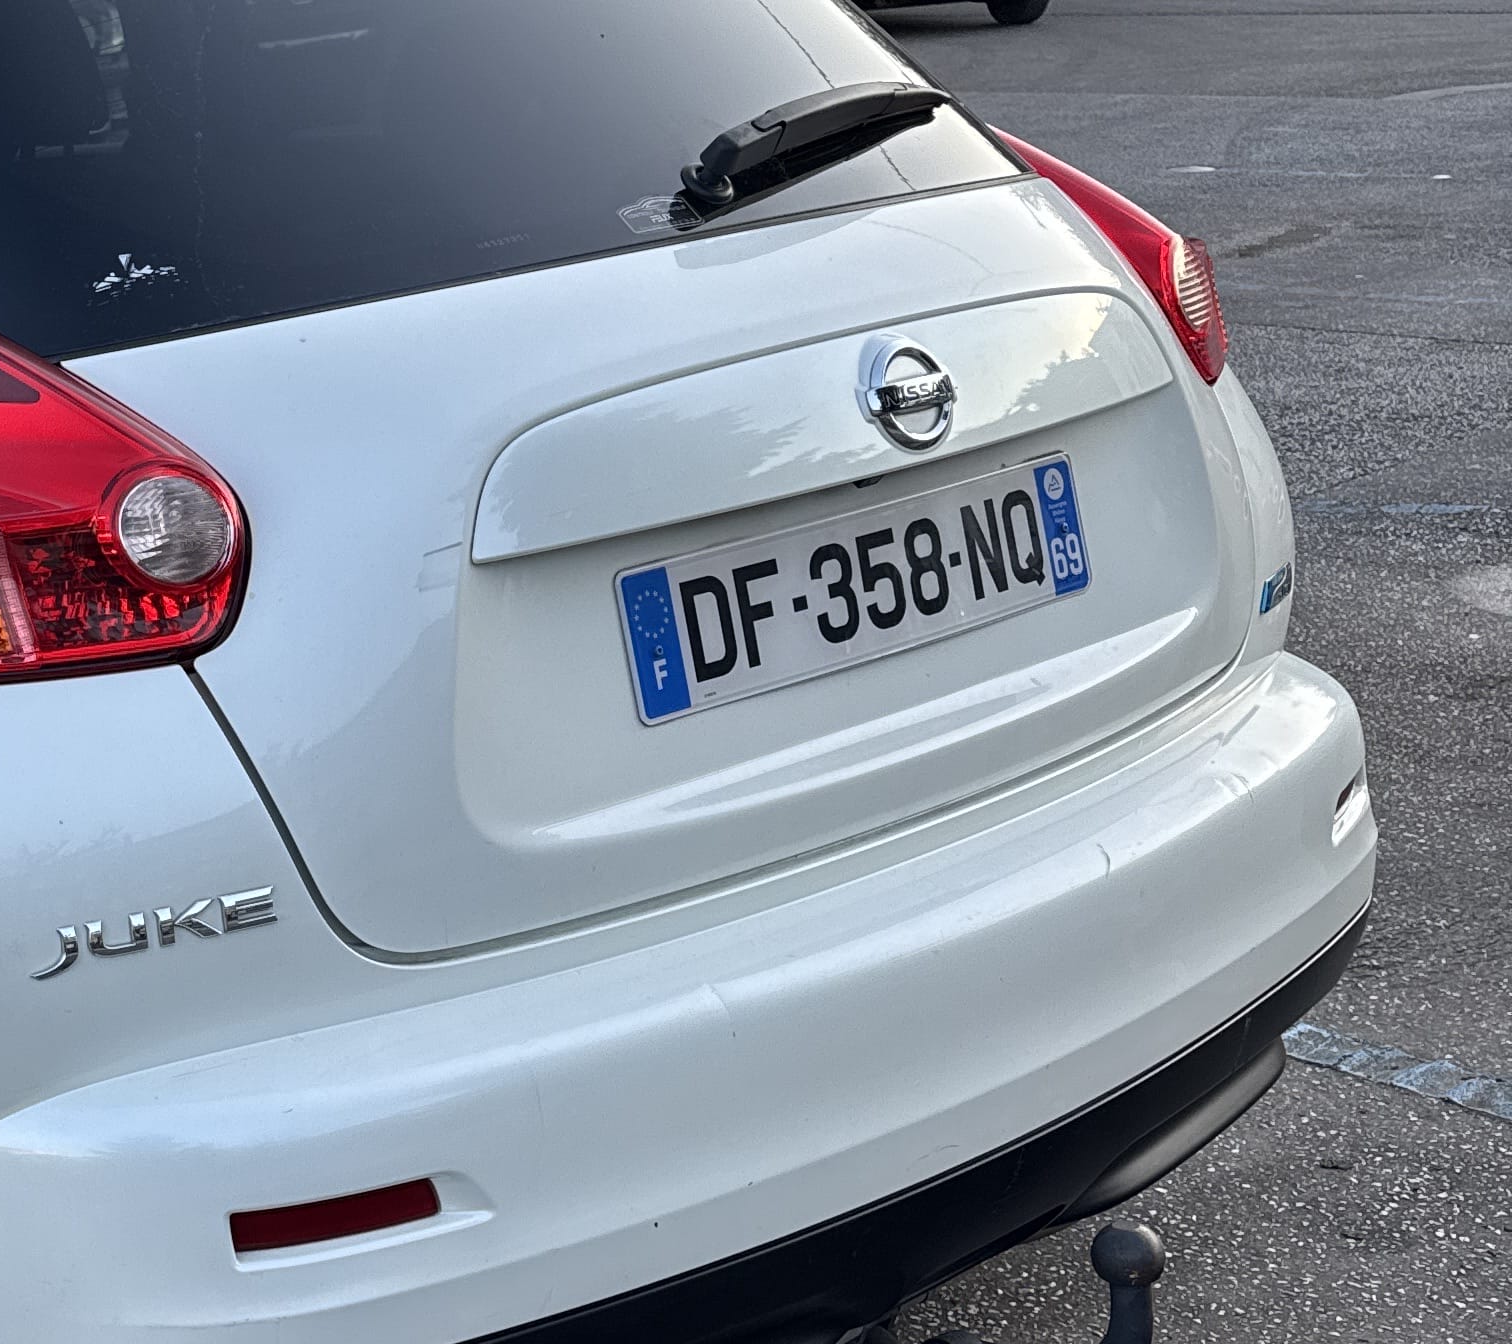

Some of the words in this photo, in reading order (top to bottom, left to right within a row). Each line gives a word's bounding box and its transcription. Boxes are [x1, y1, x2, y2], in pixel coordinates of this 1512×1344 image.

[881, 378, 952, 408] NISSAN
[1050, 532, 1084, 580] 69
[678, 489, 1046, 684] DF-358-NQ
[653, 658, 668, 691] F
[29, 884, 278, 981] JUKE
